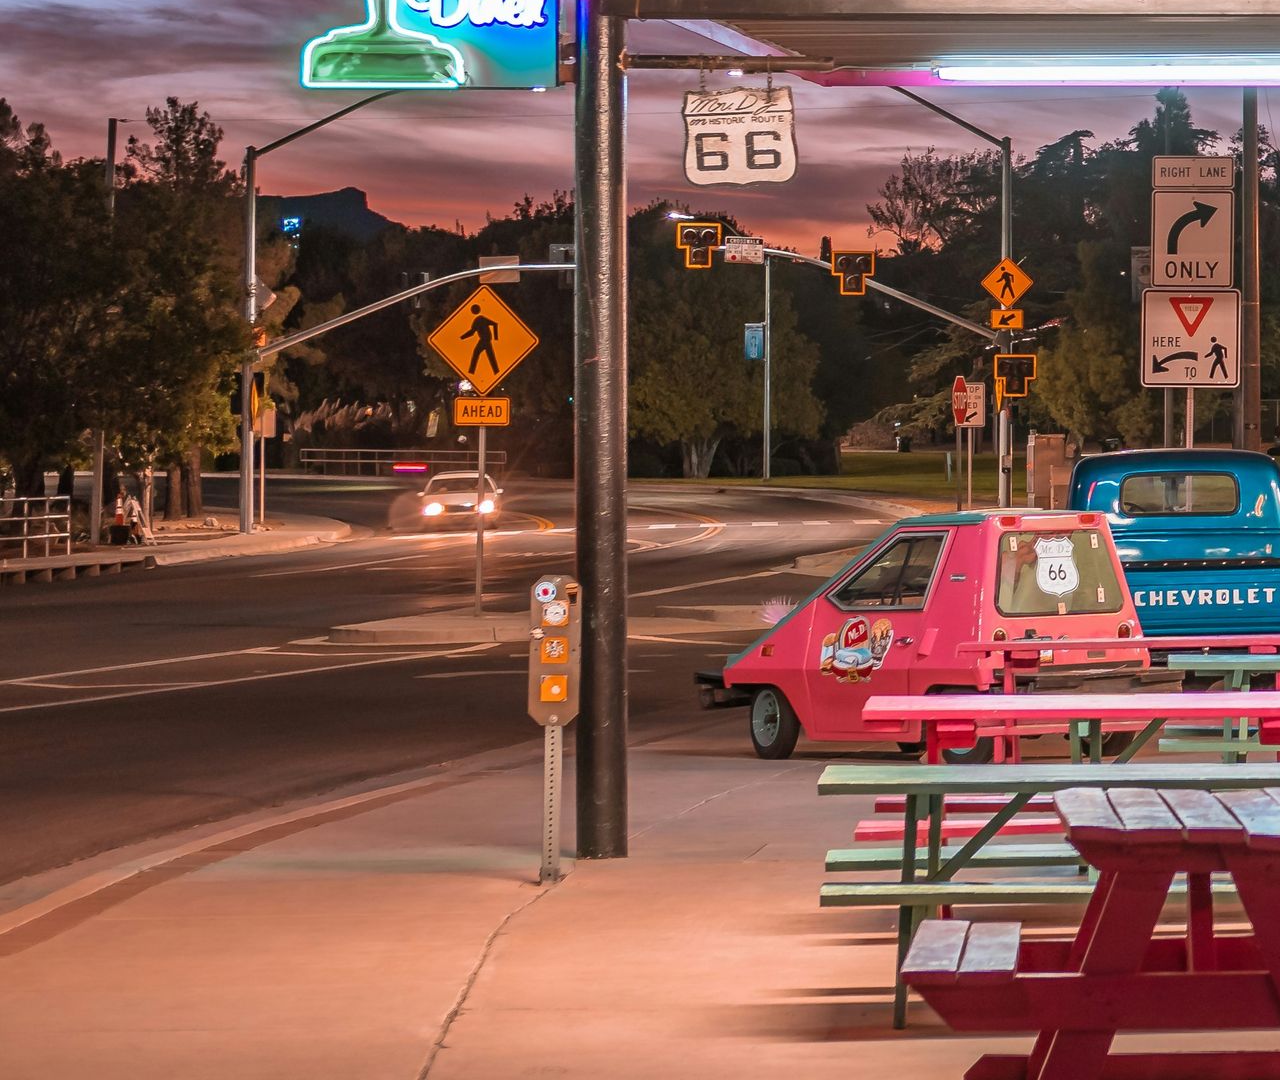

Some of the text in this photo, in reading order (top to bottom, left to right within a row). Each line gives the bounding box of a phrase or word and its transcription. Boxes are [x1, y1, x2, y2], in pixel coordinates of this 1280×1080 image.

[689, 114, 785, 126] on HISTORIC ROUTE
[694, 130, 782, 172] 66
[1160, 166, 1227, 178] RIGHT LANE
[1165, 260, 1219, 279] ONLY
[1152, 336, 1181, 348] HERE
[1184, 366, 1198, 378] TO
[954, 392, 967, 409] STOP
[462, 405, 503, 418] AHEAD
[1048, 563, 1067, 581] 66
[1134, 587, 1277, 607] CHEVROLET
